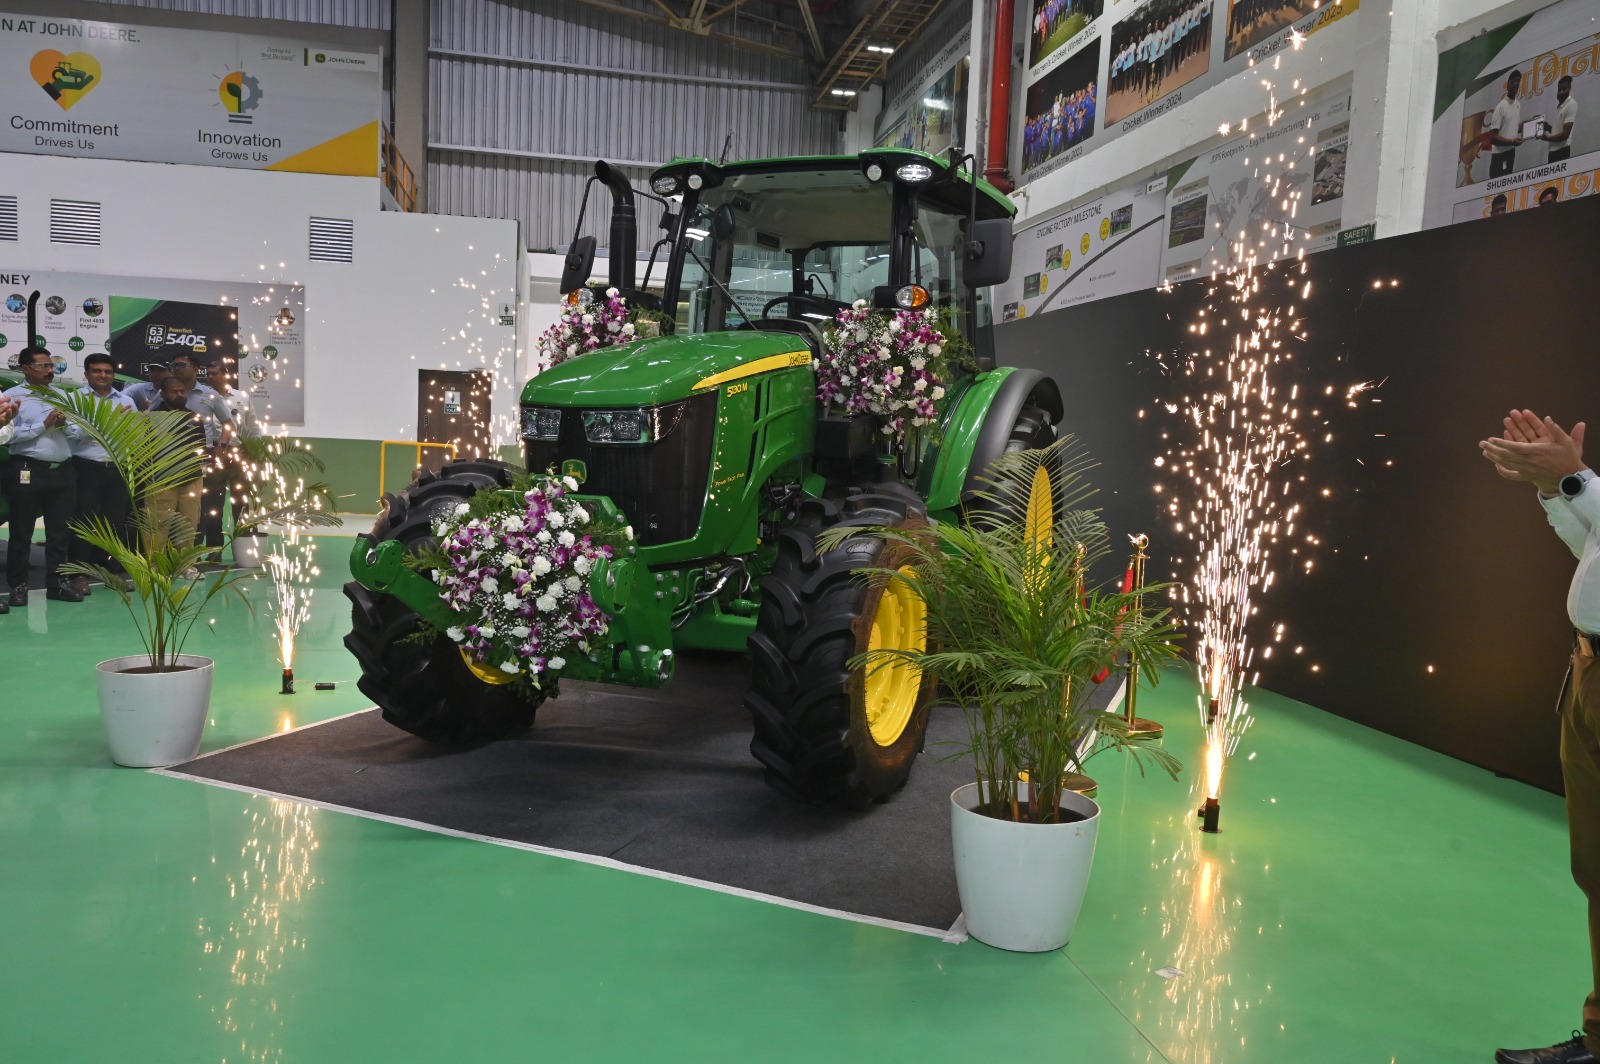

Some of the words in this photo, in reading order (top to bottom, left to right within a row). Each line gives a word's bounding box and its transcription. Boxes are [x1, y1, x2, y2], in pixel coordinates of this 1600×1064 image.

[18, 20, 36, 33] AT
[40, 22, 82, 37] JOHN
[88, 26, 140, 43] DEERE.
[1251, 36, 1281, 62] Cricket
[1284, 18, 1317, 45] Wner
[1318, 4, 1343, 26] 2025
[1051, 47, 1067, 64] Cricket
[1067, 35, 1083, 54] Winner
[1122, 112, 1143, 132] Cricket
[1143, 102, 1166, 121] Winner
[1165, 91, 1182, 110] 2024
[10, 115, 119, 137] Commitment
[1249, 135, 1266, 150] Engine
[1266, 121, 1305, 143] Manufacturing
[35, 136, 74, 148] Drives
[78, 139, 95, 150] Us
[198, 129, 282, 148] Innovation
[211, 148, 249, 160] Grows
[252, 151, 268, 162] Us
[1040, 161, 1055, 175] Cricket
[1054, 154, 1071, 171] Winner
[1486, 173, 1524, 191] SHUBHAM
[1525, 162, 1567, 181] KUMBHAR
[1036, 223, 1053, 239] ENGINE
[1053, 216, 1073, 234] FACTORY
[1073, 204, 1103, 225] MILESTONE
[1343, 227, 1369, 241] SAFETY
[0, 274, 30, 286] NEY
[148, 336, 163, 344] HP
[149, 327, 163, 336] 63
[165, 333, 206, 347] 5405
